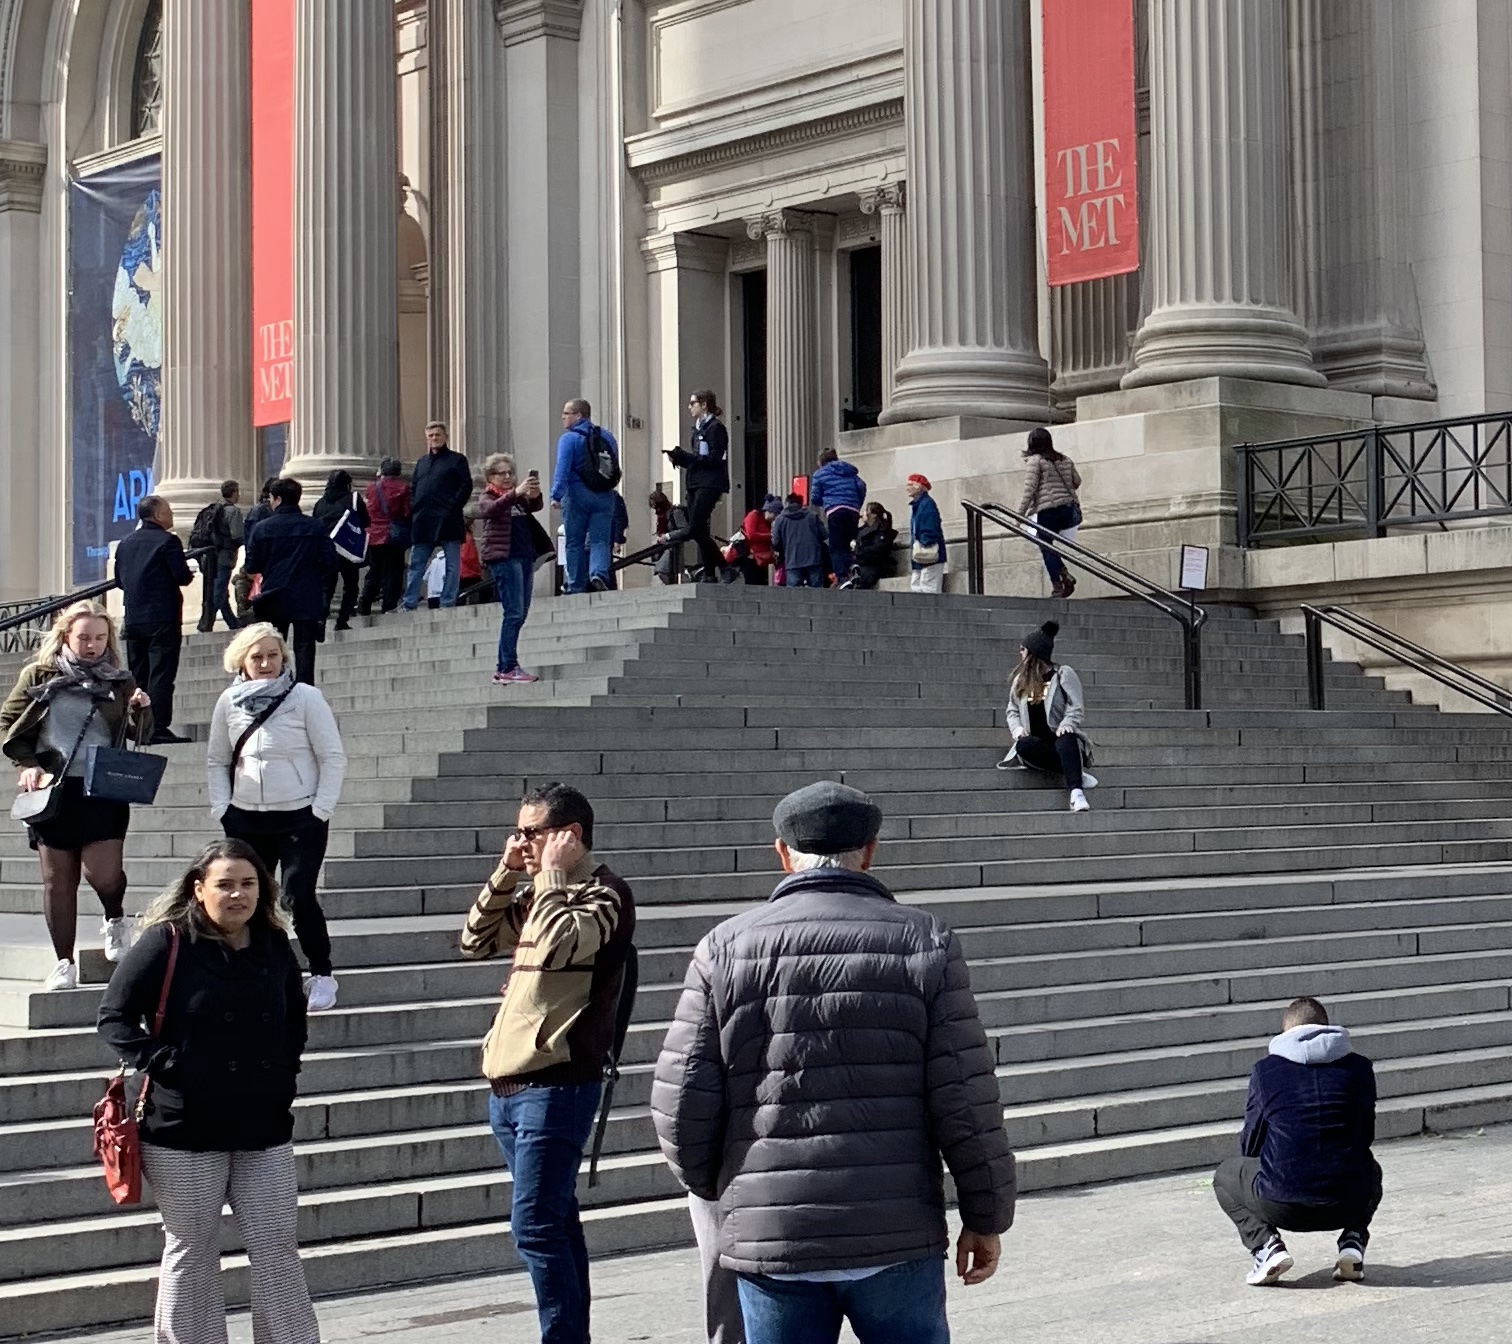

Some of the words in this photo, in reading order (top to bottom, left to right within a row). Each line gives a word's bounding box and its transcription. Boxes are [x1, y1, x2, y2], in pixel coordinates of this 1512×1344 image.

[1057, 137, 1123, 199] THE
[1057, 193, 1126, 256] MET
[260, 319, 294, 362] THE
[260, 359, 294, 404] MET
